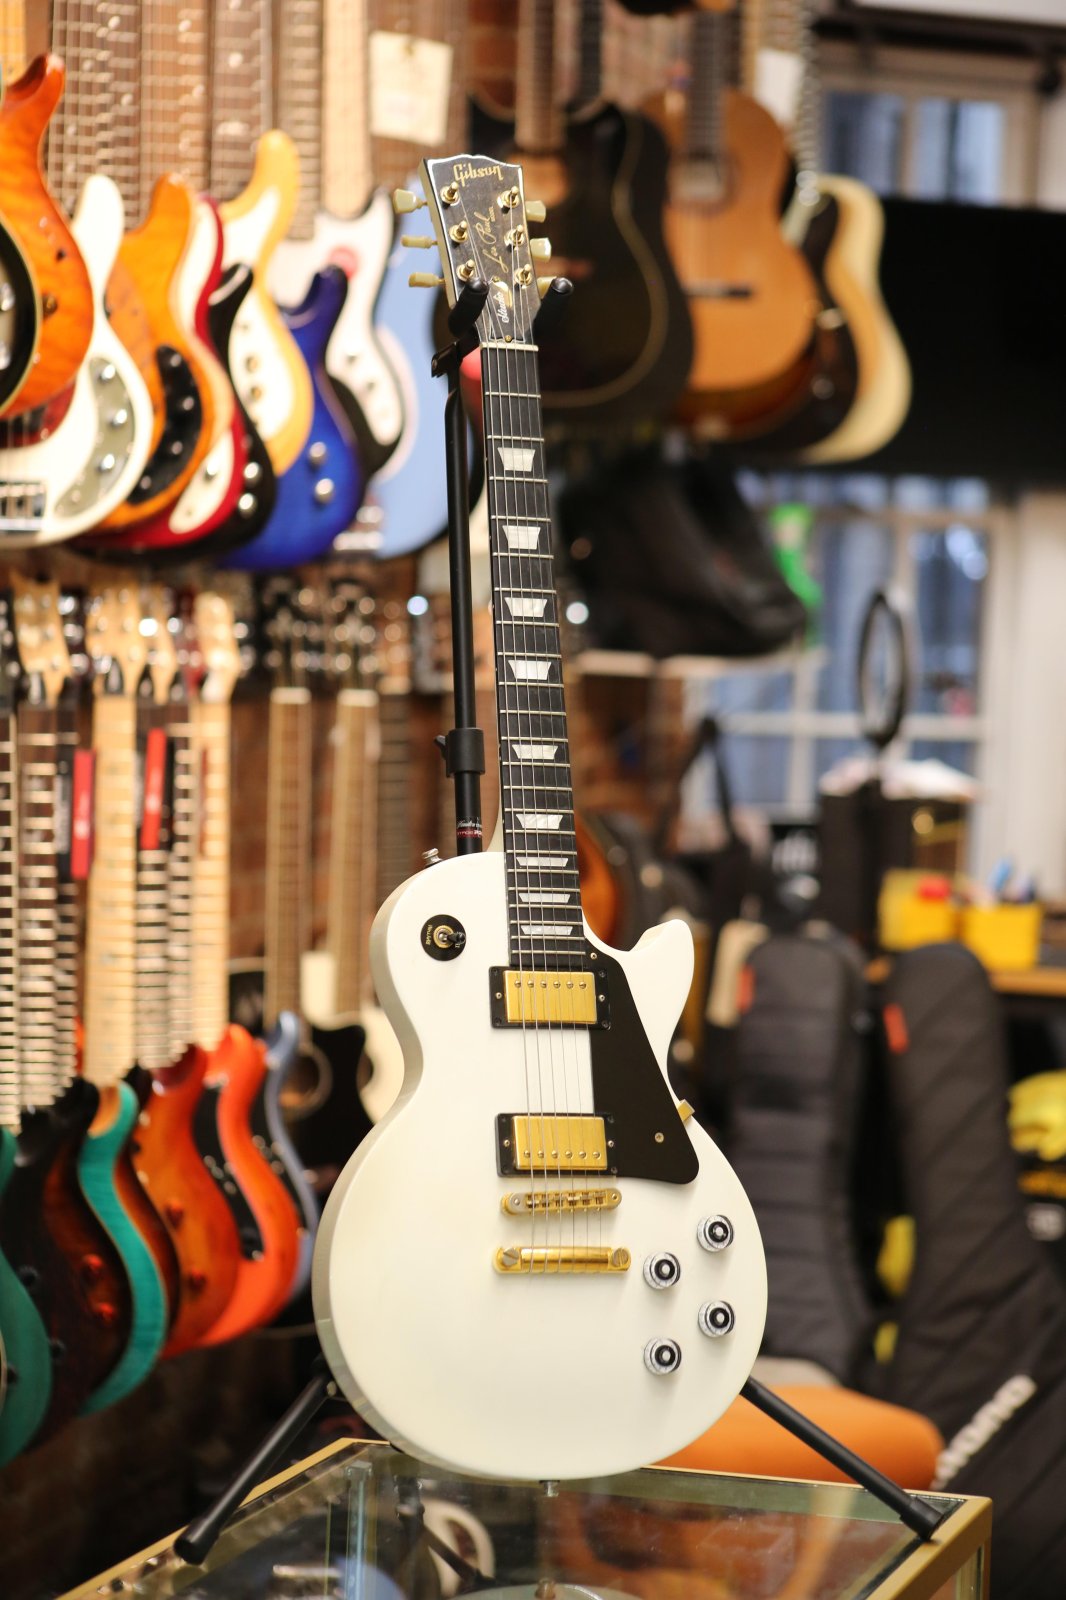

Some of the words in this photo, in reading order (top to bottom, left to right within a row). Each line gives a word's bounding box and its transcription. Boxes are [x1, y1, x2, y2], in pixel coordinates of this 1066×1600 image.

[453, 162, 504, 187] Gibson
[474, 211, 497, 245] Paul
[482, 246, 509, 274] Les
[493, 291, 510, 323] Studio
